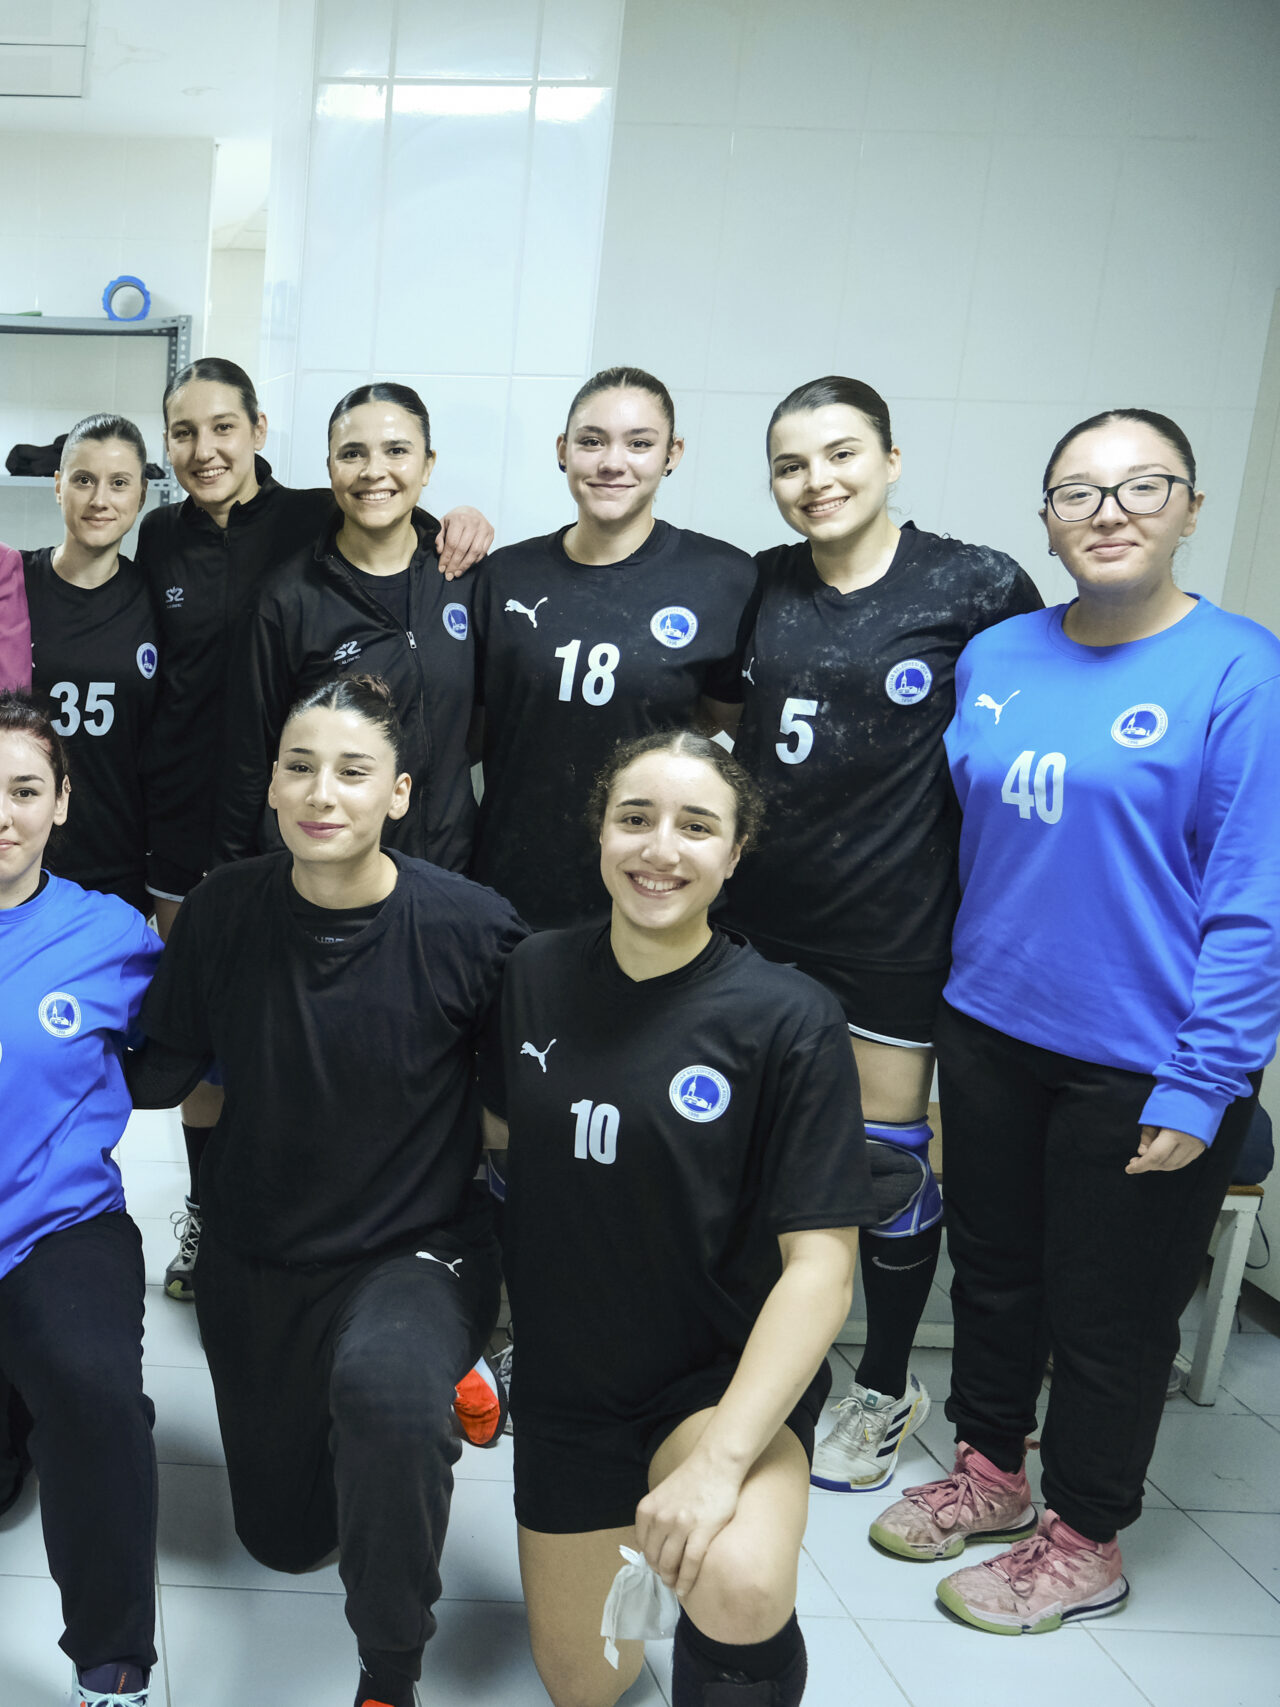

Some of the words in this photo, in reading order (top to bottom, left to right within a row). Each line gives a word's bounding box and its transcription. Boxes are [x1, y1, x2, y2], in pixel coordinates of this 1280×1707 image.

[555, 640, 620, 706] 18
[50, 682, 116, 737] 35
[776, 698, 818, 764] 5
[1002, 751, 1066, 824] 40
[571, 1099, 620, 1164] 10
